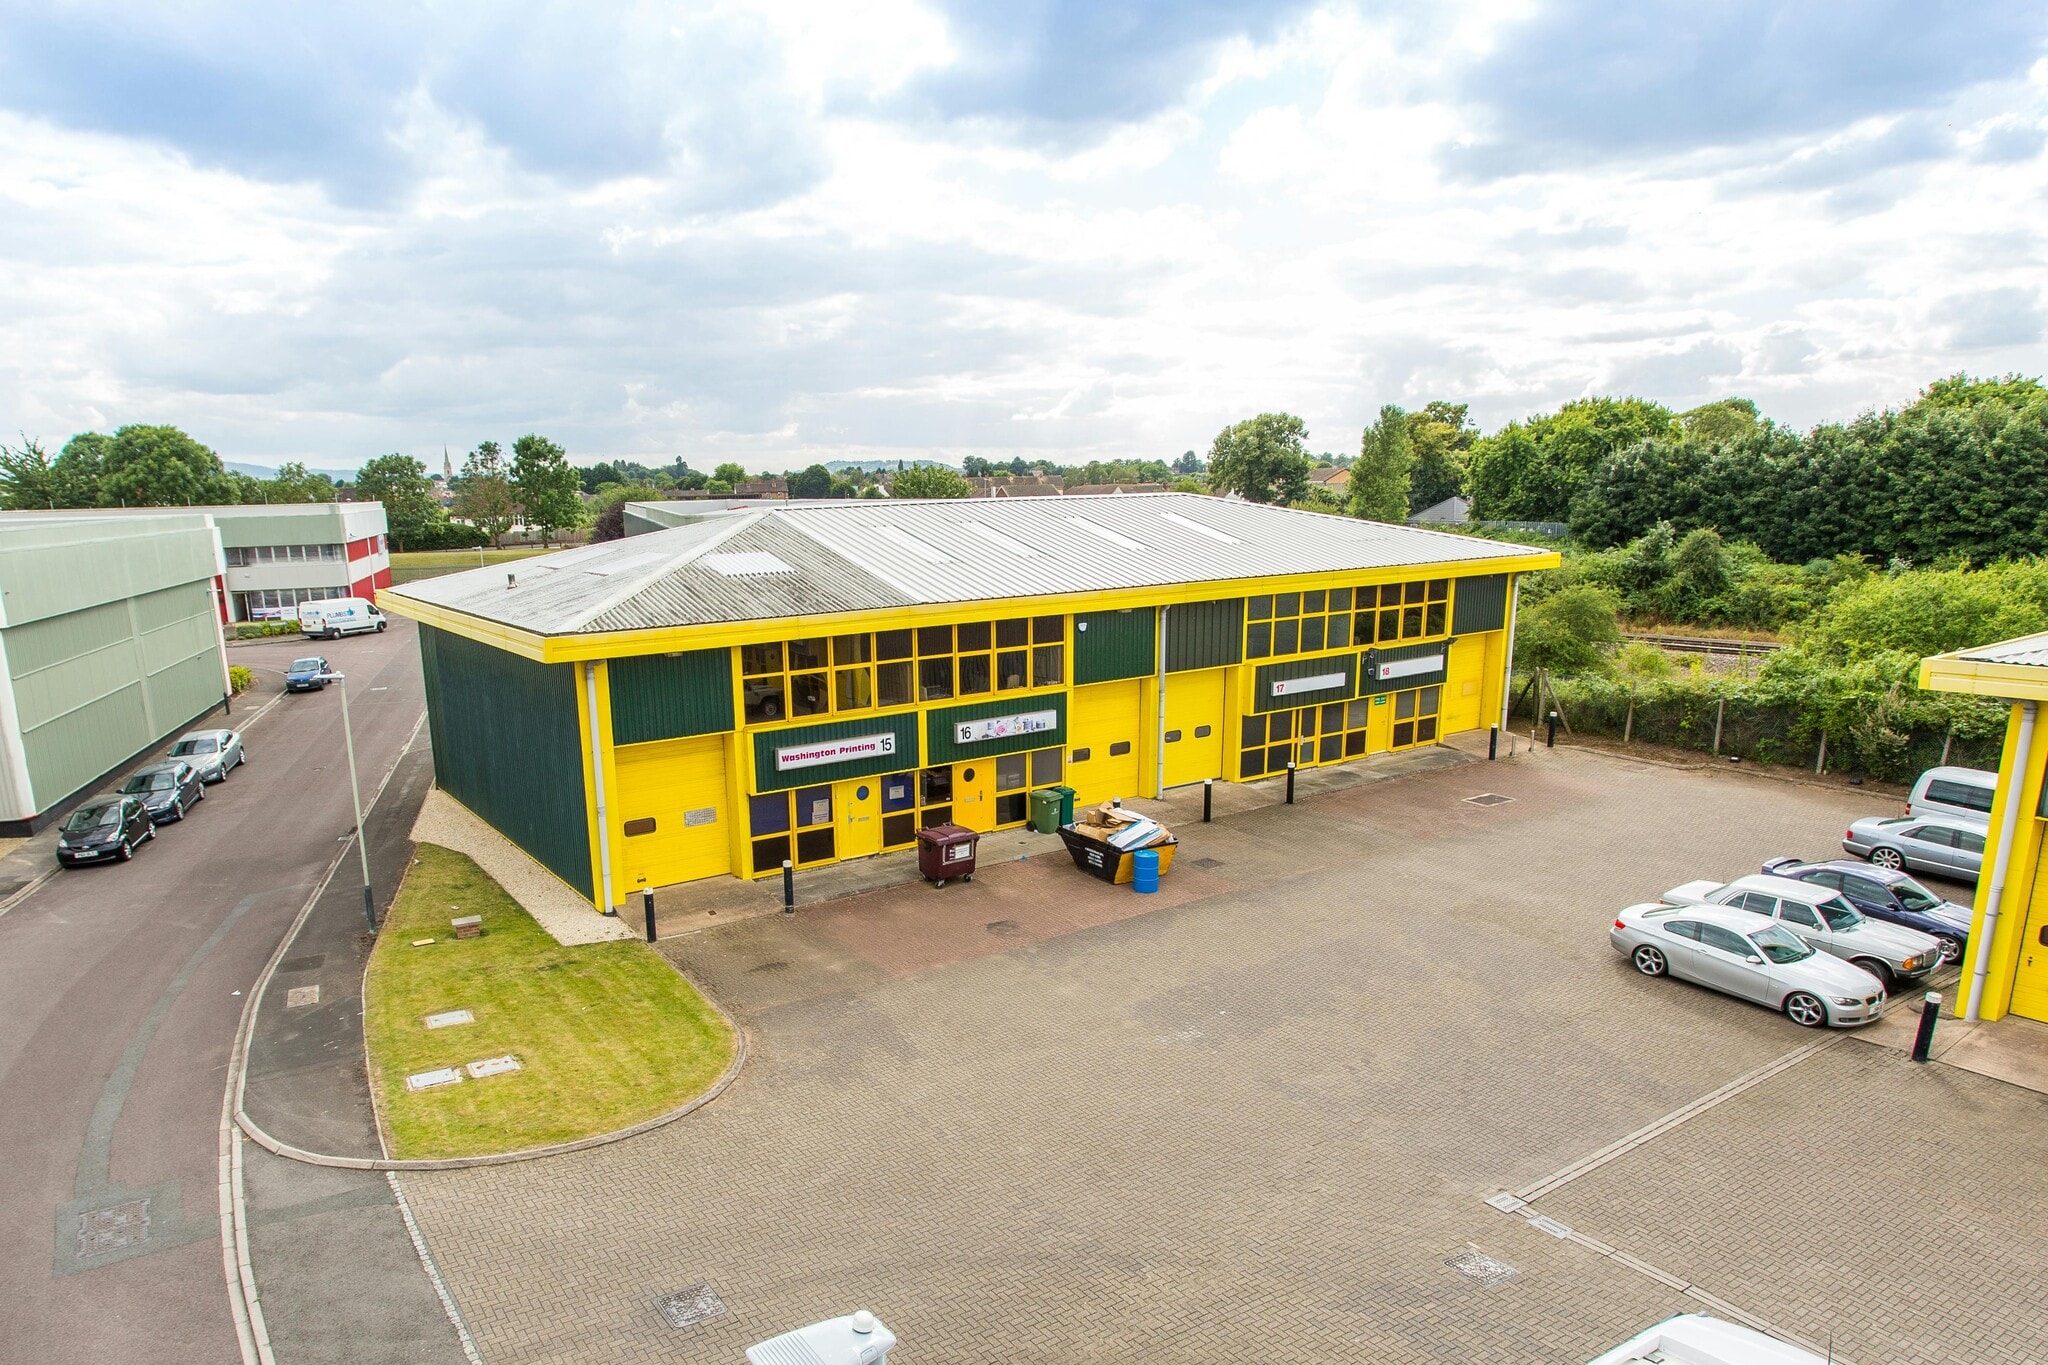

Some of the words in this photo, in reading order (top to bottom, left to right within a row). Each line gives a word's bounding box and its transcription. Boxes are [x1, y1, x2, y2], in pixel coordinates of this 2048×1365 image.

[1382, 667, 1390, 675] 18
[1276, 684, 1284, 693] 17
[960, 726, 971, 740] 16
[781, 749, 836, 762] Washington
[839, 743, 876, 754] Printing
[880, 737, 892, 752] 15
